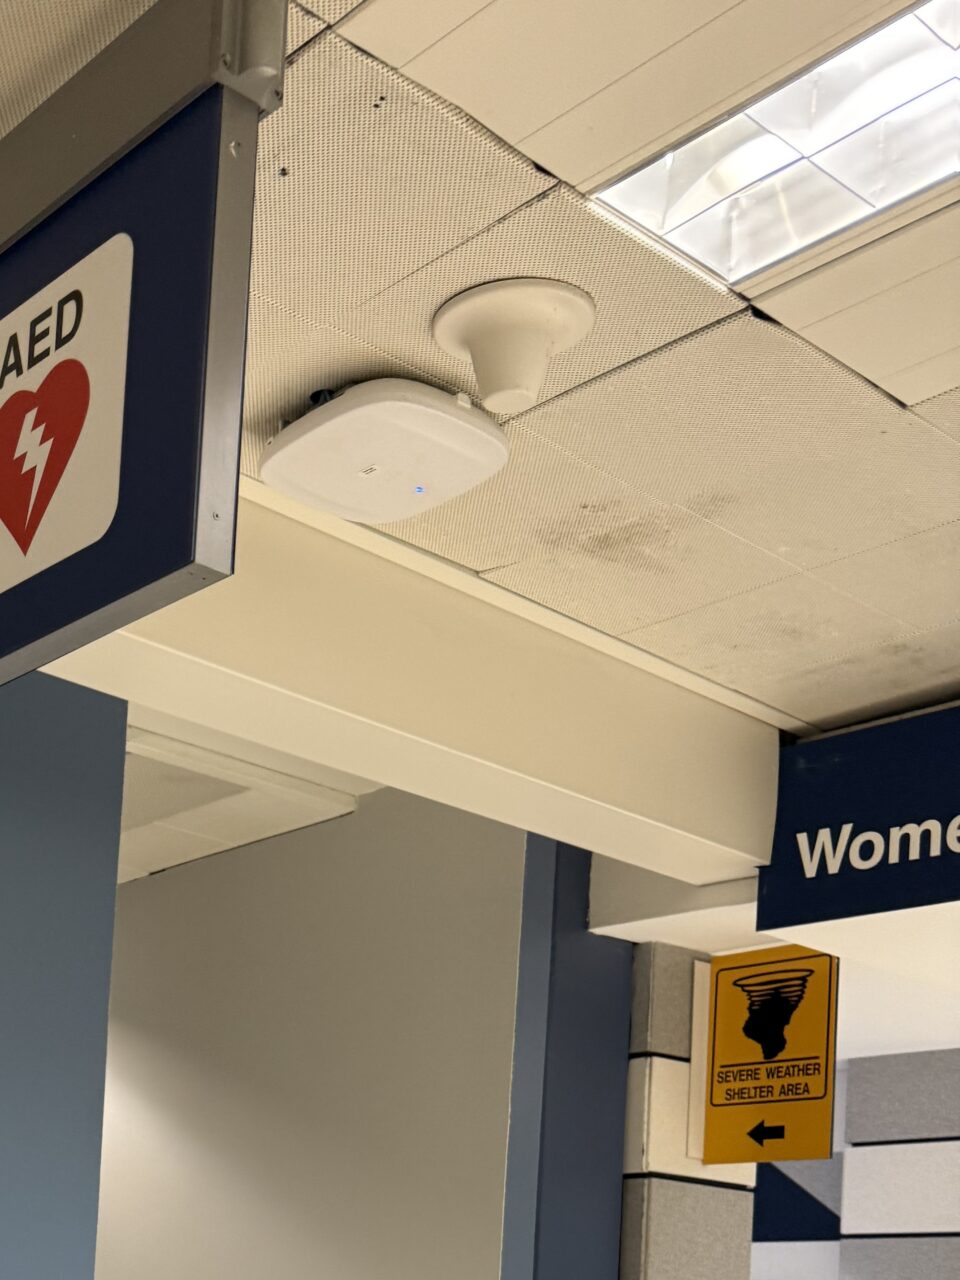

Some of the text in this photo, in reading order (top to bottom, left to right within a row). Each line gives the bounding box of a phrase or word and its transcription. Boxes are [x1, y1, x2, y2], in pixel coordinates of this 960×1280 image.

[717, 1062, 821, 1084] SEVERE WEATHER
[725, 1082, 810, 1101] SHELTER AREA
